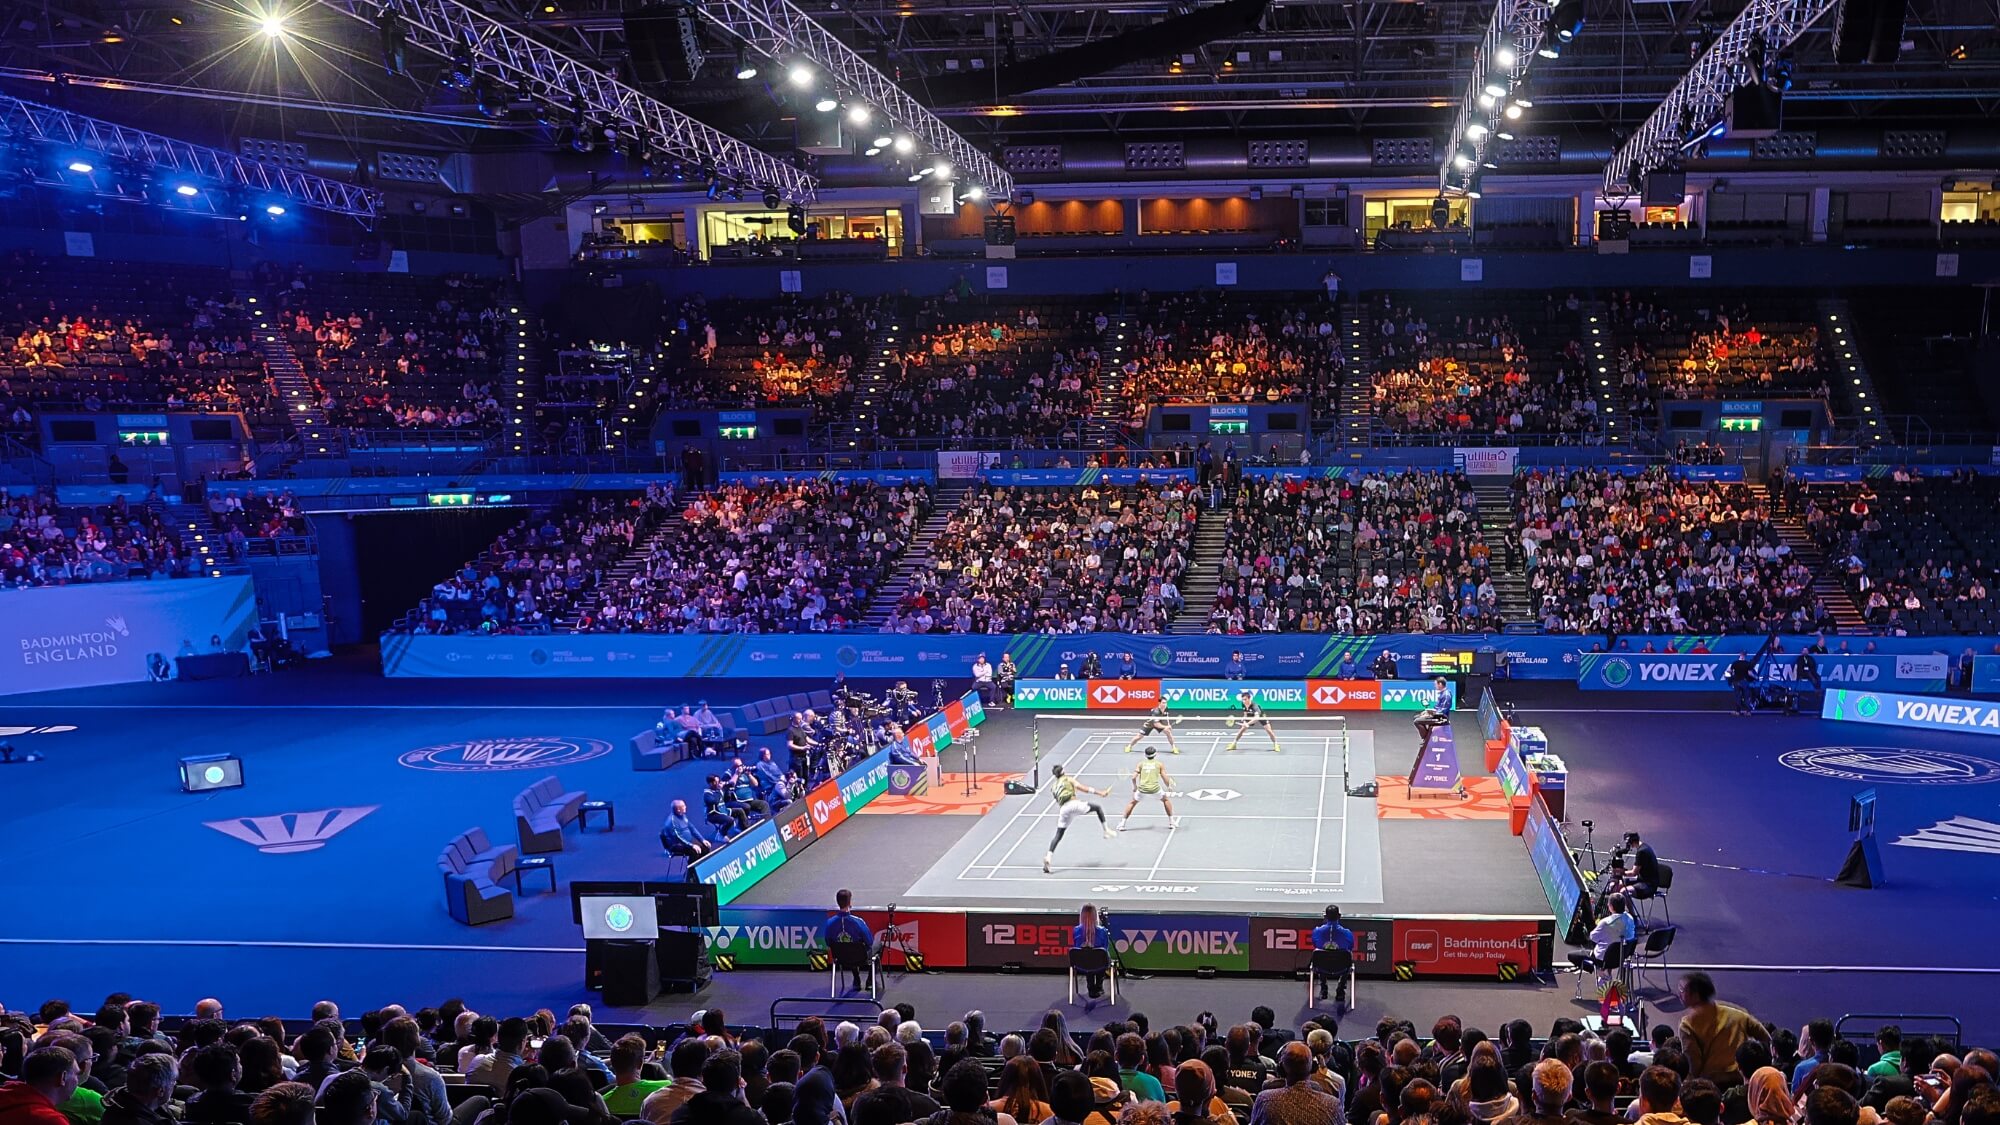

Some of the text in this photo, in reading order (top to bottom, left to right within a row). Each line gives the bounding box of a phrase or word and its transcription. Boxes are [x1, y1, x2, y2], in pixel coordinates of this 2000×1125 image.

[21, 631, 116, 650] BADMINTON
[24, 645, 118, 665] ENGLAND
[1460, 664, 1471, 674] 11
[1640, 663, 1718, 681] YONEX
[1769, 663, 1880, 682] ENLAND
[1042, 688, 1083, 701] YONEX
[1128, 690, 1156, 699] HSBC
[1188, 688, 1229, 701] YONEX
[1262, 688, 1304, 702] YONEX
[1348, 691, 1377, 700] HSBC
[1897, 700, 1981, 726] YONEX
[1435, 753, 1441, 761] 1
[849, 775, 869, 798] YONEX
[781, 813, 808, 842] 12BET
[756, 833, 781, 861] YONEX
[717, 856, 746, 887] YONEX
[1134, 885, 1199, 893] YONEX
[744, 925, 818, 949] YONEX
[1163, 930, 1239, 955] YONEX
[1263, 928, 1366, 950] 12BT
[1444, 937, 1527, 949] Badminton4U
[1443, 951, 1506, 961] Get the App Today
[1230, 1070, 1258, 1079] YONEX
